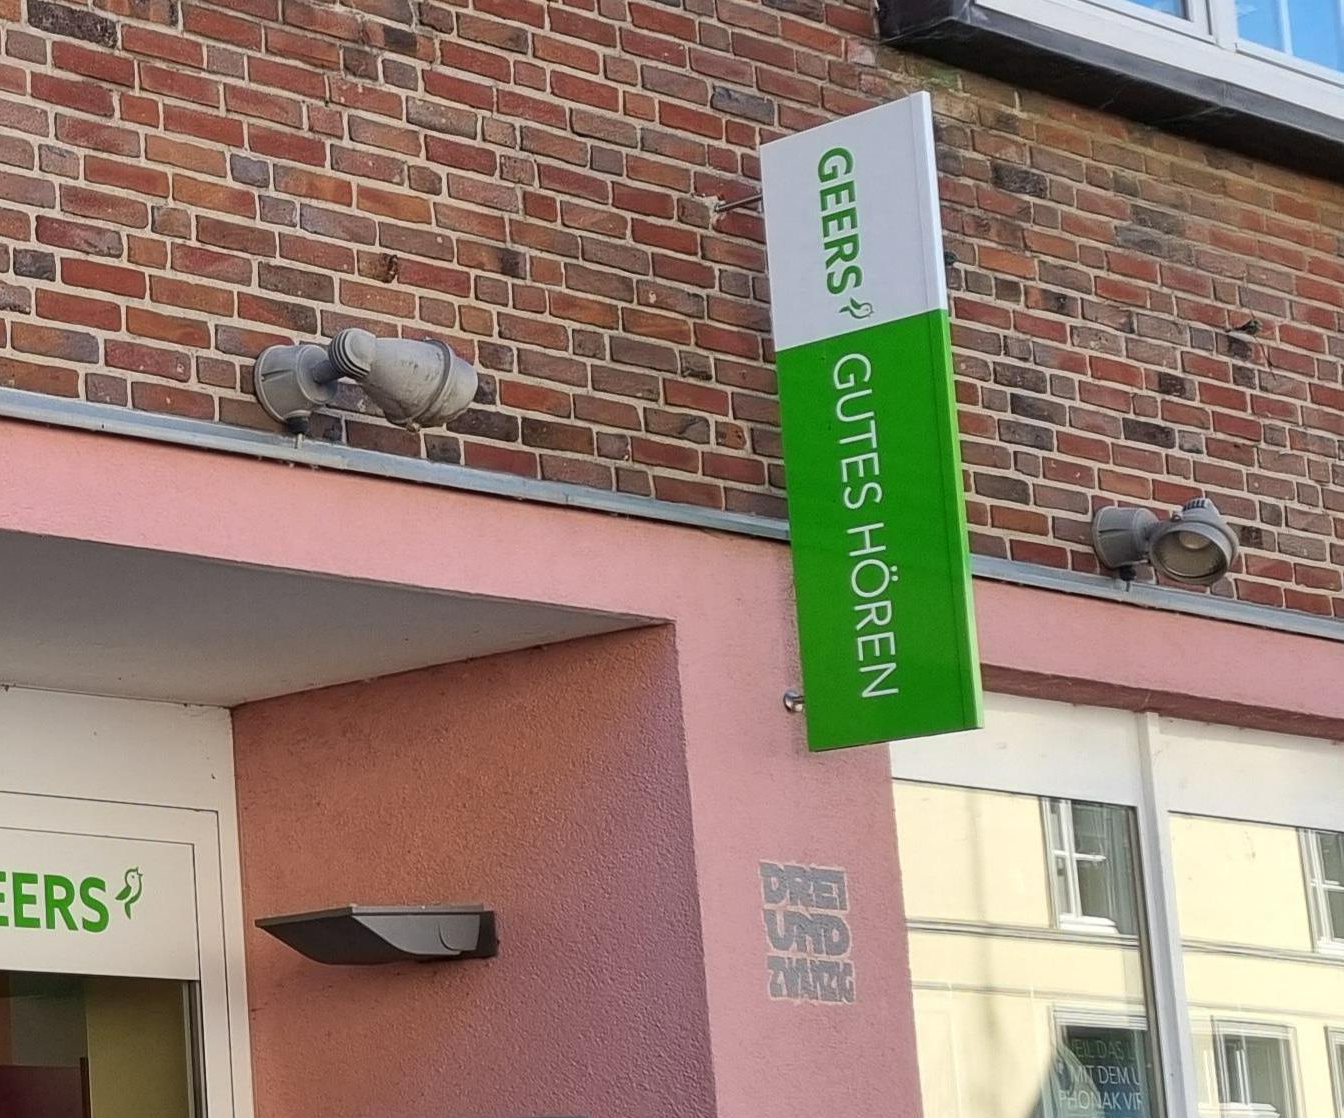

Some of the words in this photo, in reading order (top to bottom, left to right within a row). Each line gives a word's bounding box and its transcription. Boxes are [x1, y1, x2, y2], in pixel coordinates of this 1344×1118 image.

[818, 147, 862, 296] GEERS
[833, 354, 882, 510] GUTES
[843, 522, 899, 698] HÖREN
[760, 862, 848, 911] DREI
[763, 909, 851, 957] UND
[1059, 1090, 1122, 1110] PHONAK
[1099, 1066, 1131, 1085] DEM
